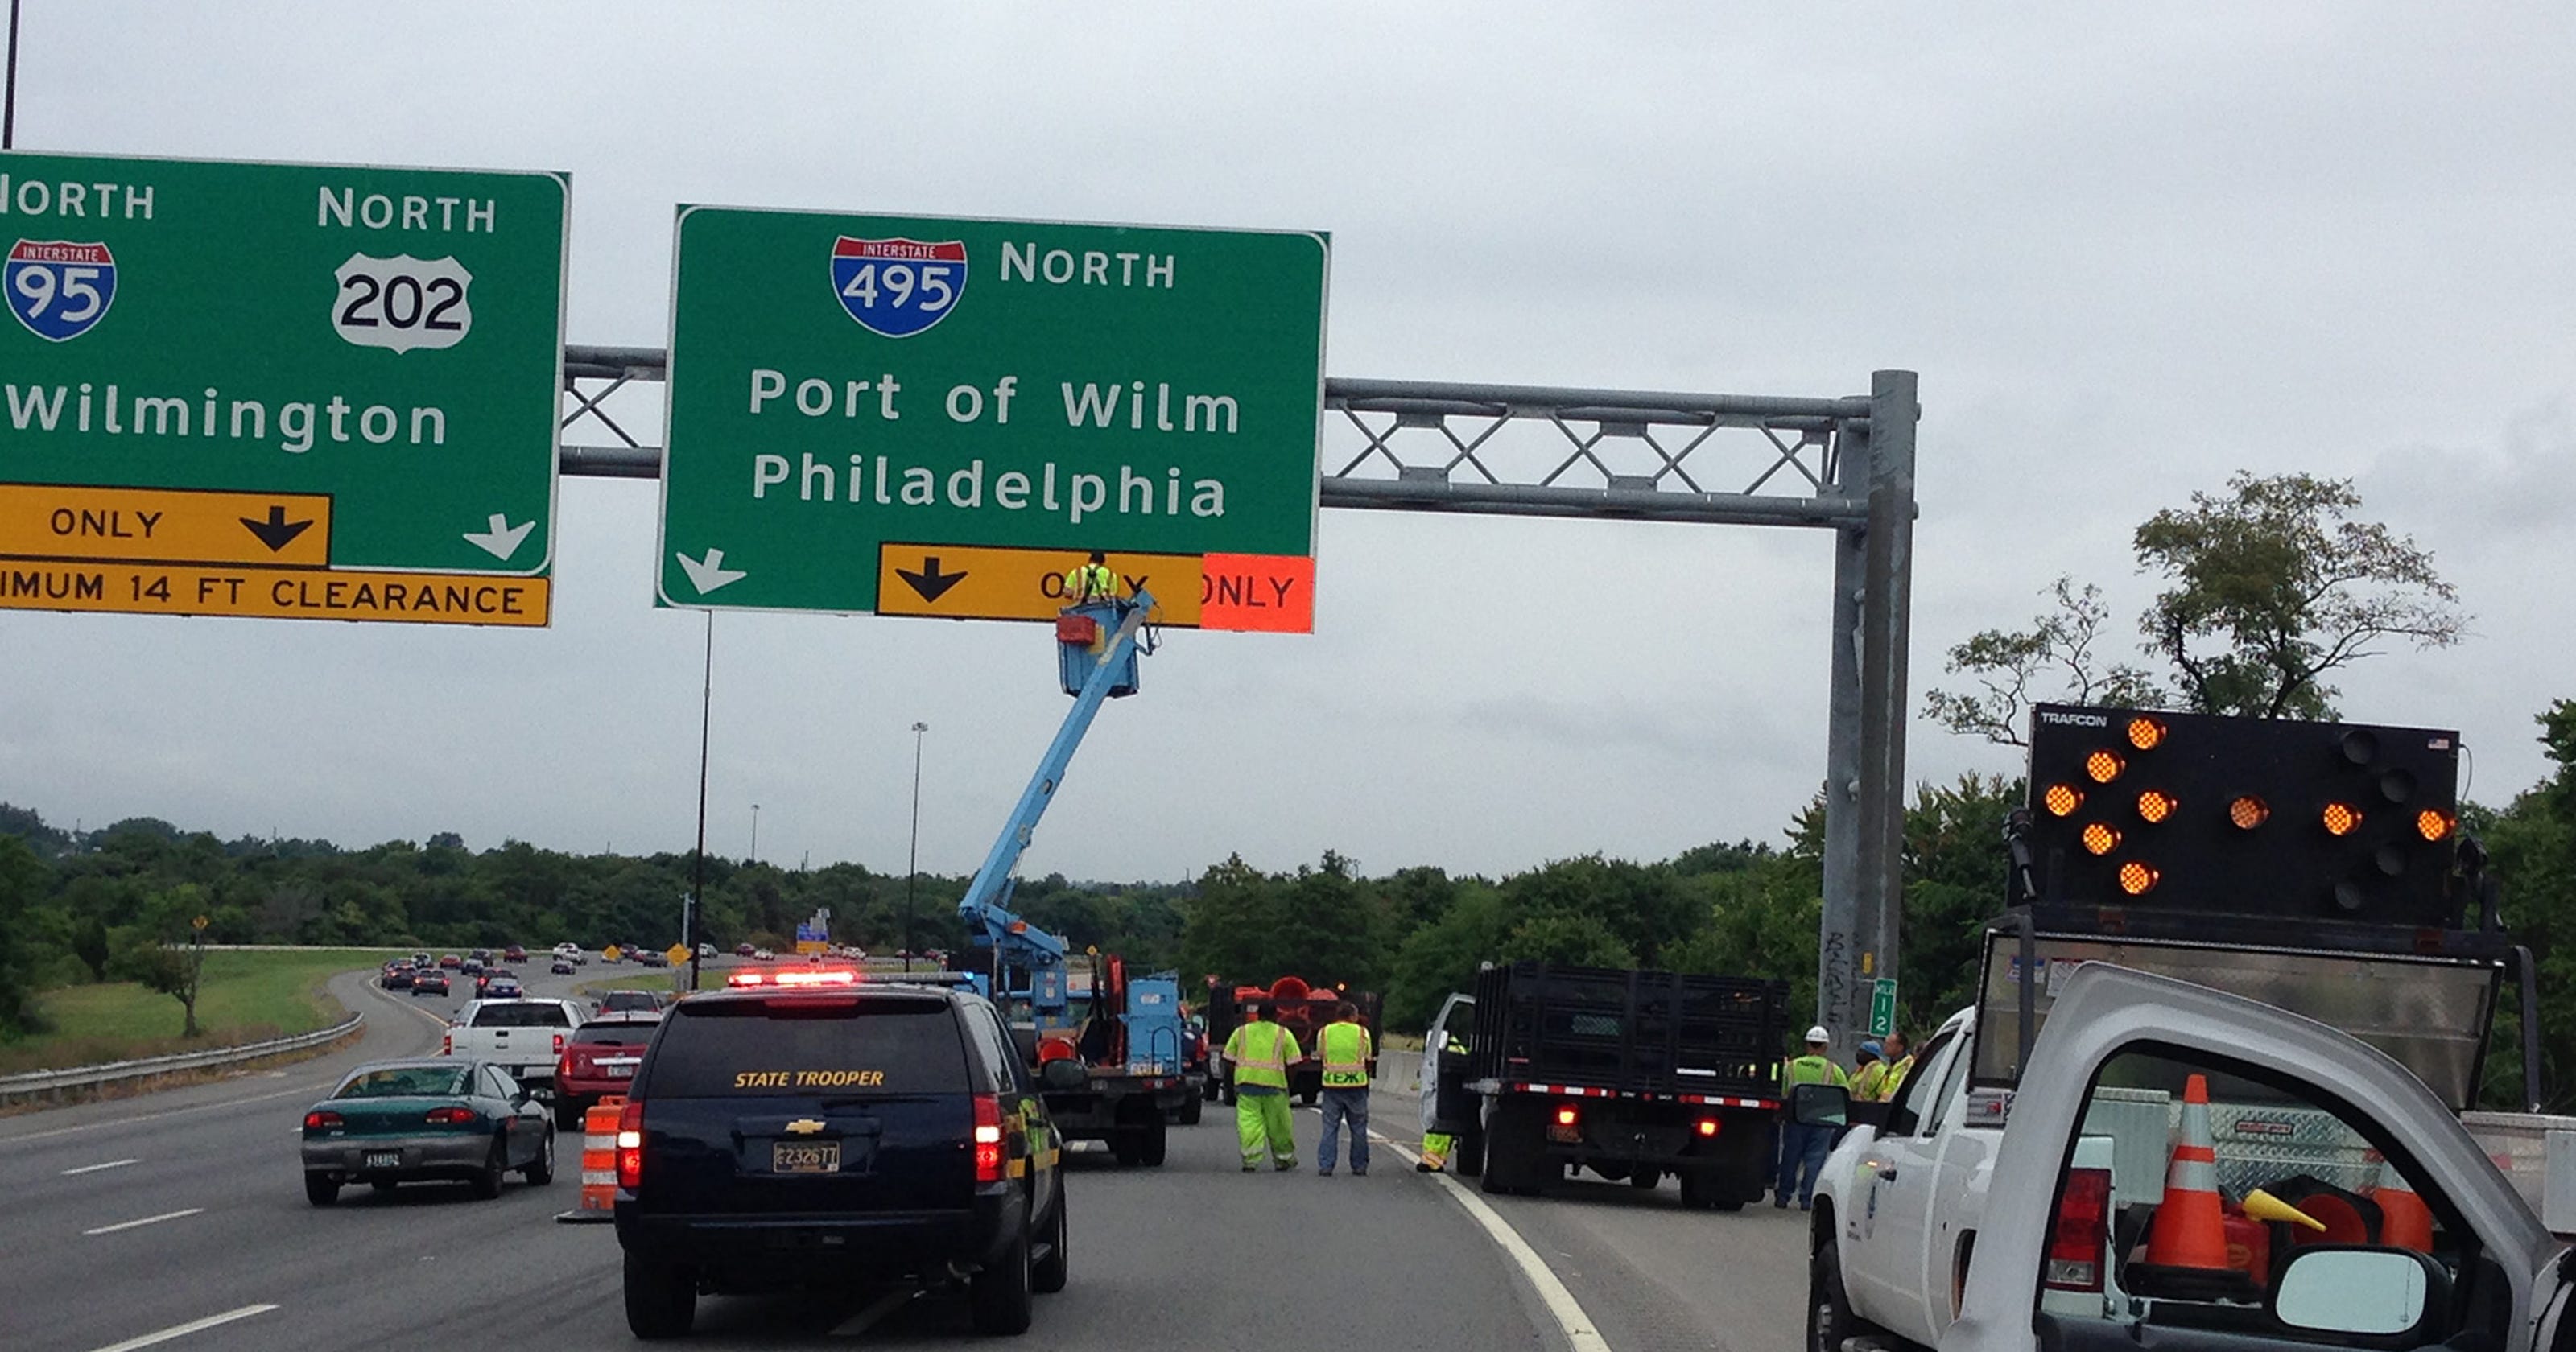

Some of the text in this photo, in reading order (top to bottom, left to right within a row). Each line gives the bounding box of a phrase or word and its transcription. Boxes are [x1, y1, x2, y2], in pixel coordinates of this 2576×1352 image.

[0, 173, 154, 220] ORTH
[318, 186, 496, 233] NORTH
[23, 245, 99, 262] INTERSTATE
[863, 244, 936, 258] INTERSTATE
[1001, 241, 1174, 288] NORTH
[16, 266, 101, 322] 95
[341, 274, 464, 331] 202
[843, 264, 952, 311] 495
[5, 383, 446, 453] Wilmington
[749, 369, 1240, 434] Port of Wilm
[753, 453, 1226, 525] Philadelphia
[51, 508, 162, 538] ONLY
[131, 576, 171, 602] 14
[198, 578, 245, 605] FT
[271, 580, 525, 615] CLEARANCE
[1041, 571, 1149, 600] OY
[2041, 711, 2107, 728] TRAFCON
[734, 1070, 884, 1088] STATE TROOPER
